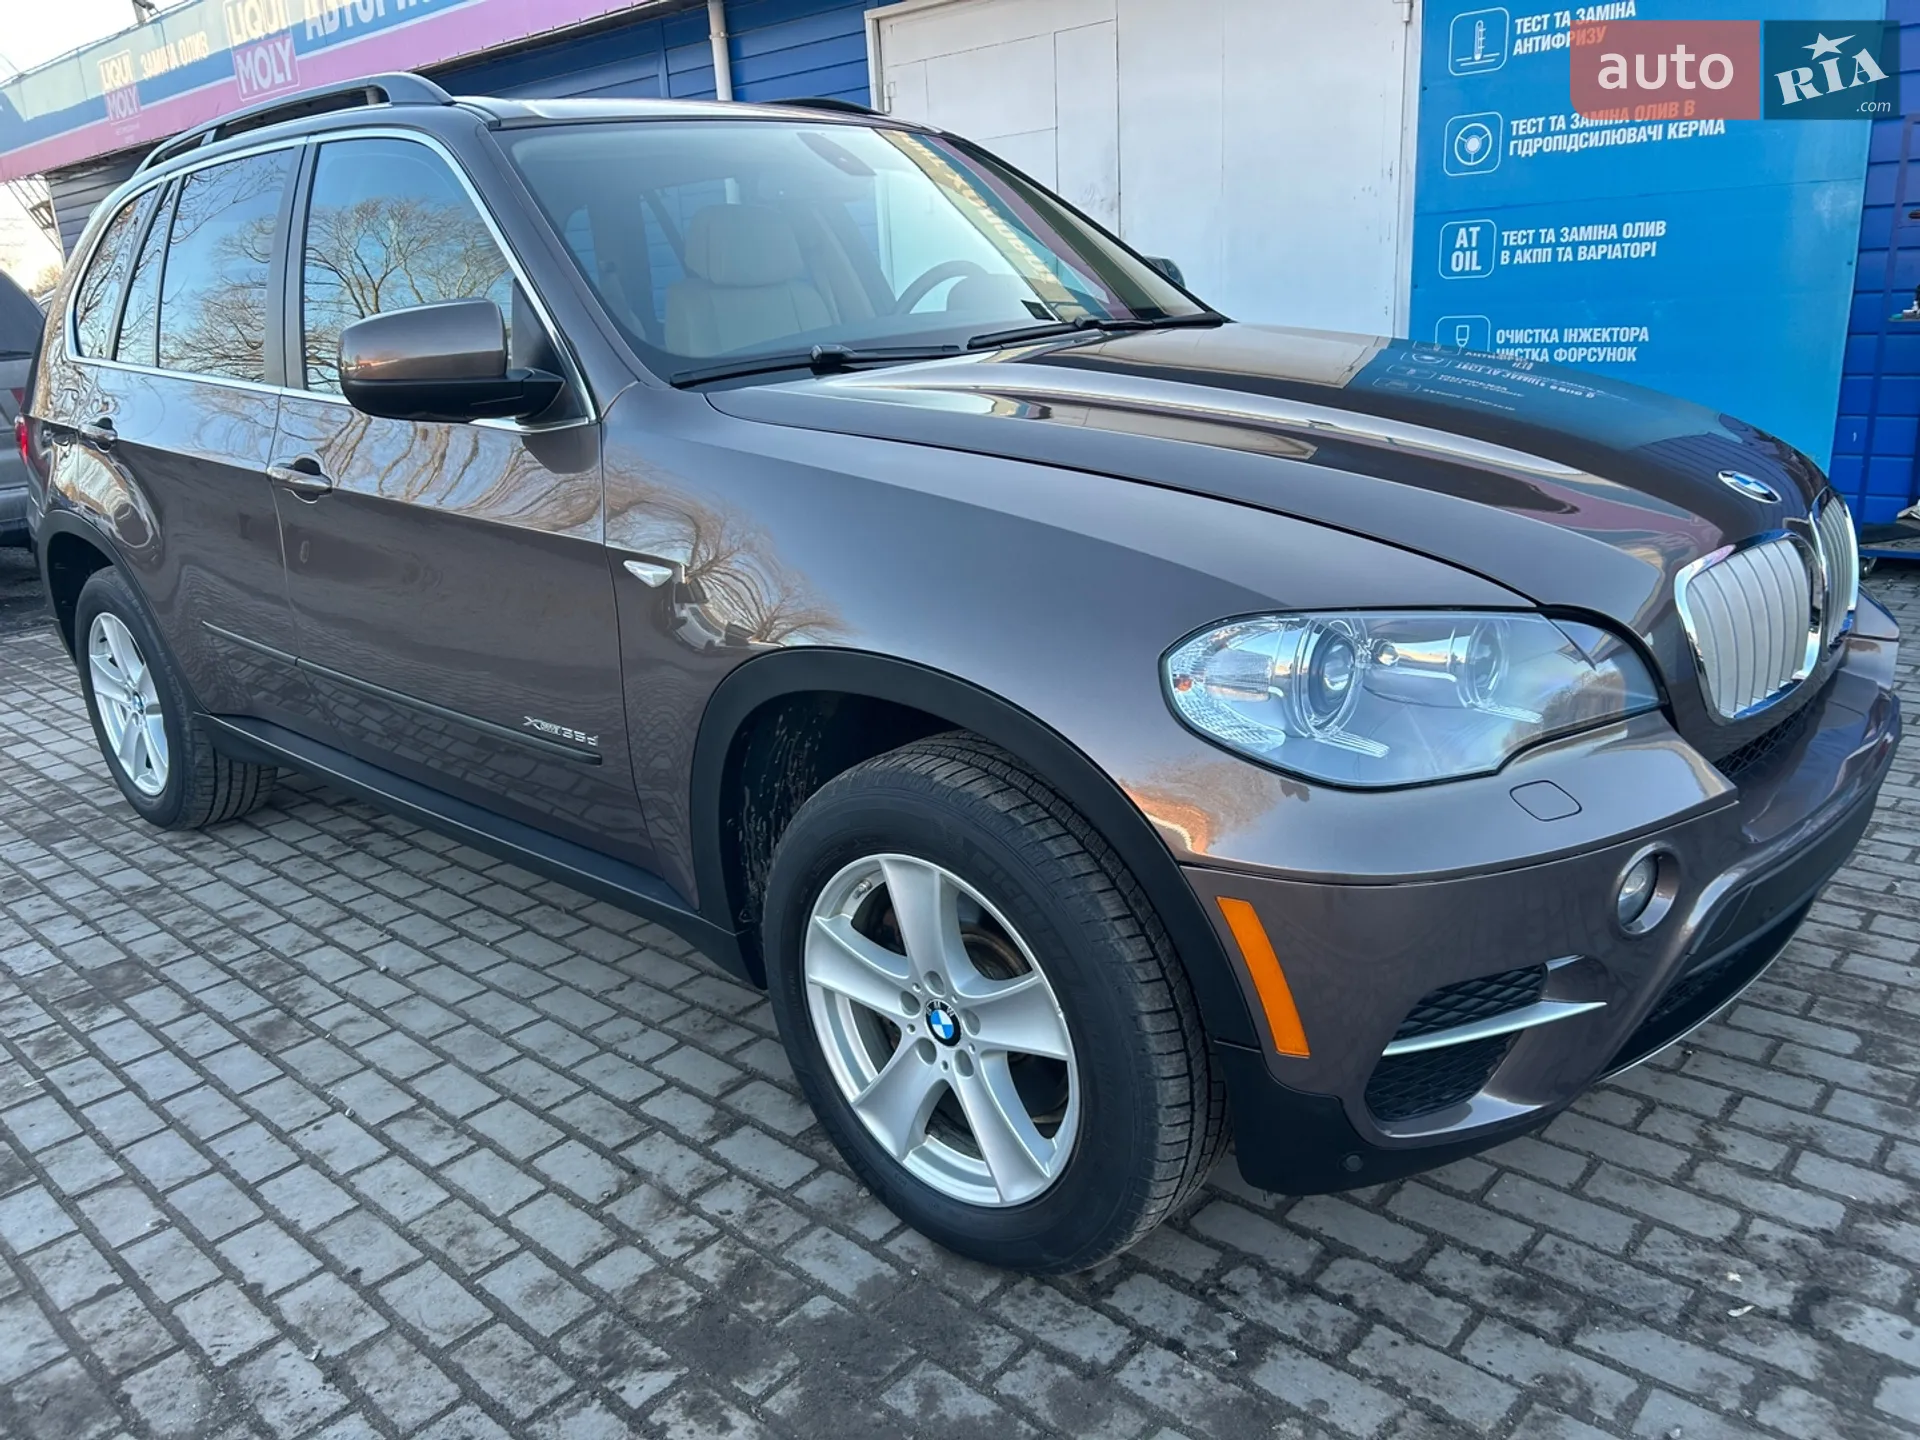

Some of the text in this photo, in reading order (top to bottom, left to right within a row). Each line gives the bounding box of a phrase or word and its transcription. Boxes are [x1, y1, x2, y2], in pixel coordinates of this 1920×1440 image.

[227, 0, 288, 47] LIQUI
[1514, 0, 1637, 35] ТЕСТ ТА ЗАМІНА
[1513, 25, 1608, 56] АНТИФРИЗУ
[100, 54, 134, 91] LIQUI
[235, 38, 292, 94] MOLY
[106, 84, 139, 120] MOLY
[1510, 99, 1696, 136] ТЕСТ ТА ЗАМІНА ОЛИВ В
[1509, 119, 1726, 157] ГІДРОПІДСИЛЮВАЧІ КЕРМА
[1502, 220, 1667, 247] ТЕСТ ТА ЗАМІНА ОЛИВ
[1450, 250, 1482, 272] OIL
[1500, 241, 1657, 265] В АКПП ТА ВАРІАТОРІ
[1496, 326, 1649, 344] ОЧИСТКА ІНЖЕКТОРА
[1553, 346, 1638, 362] ФОРСУНОК
